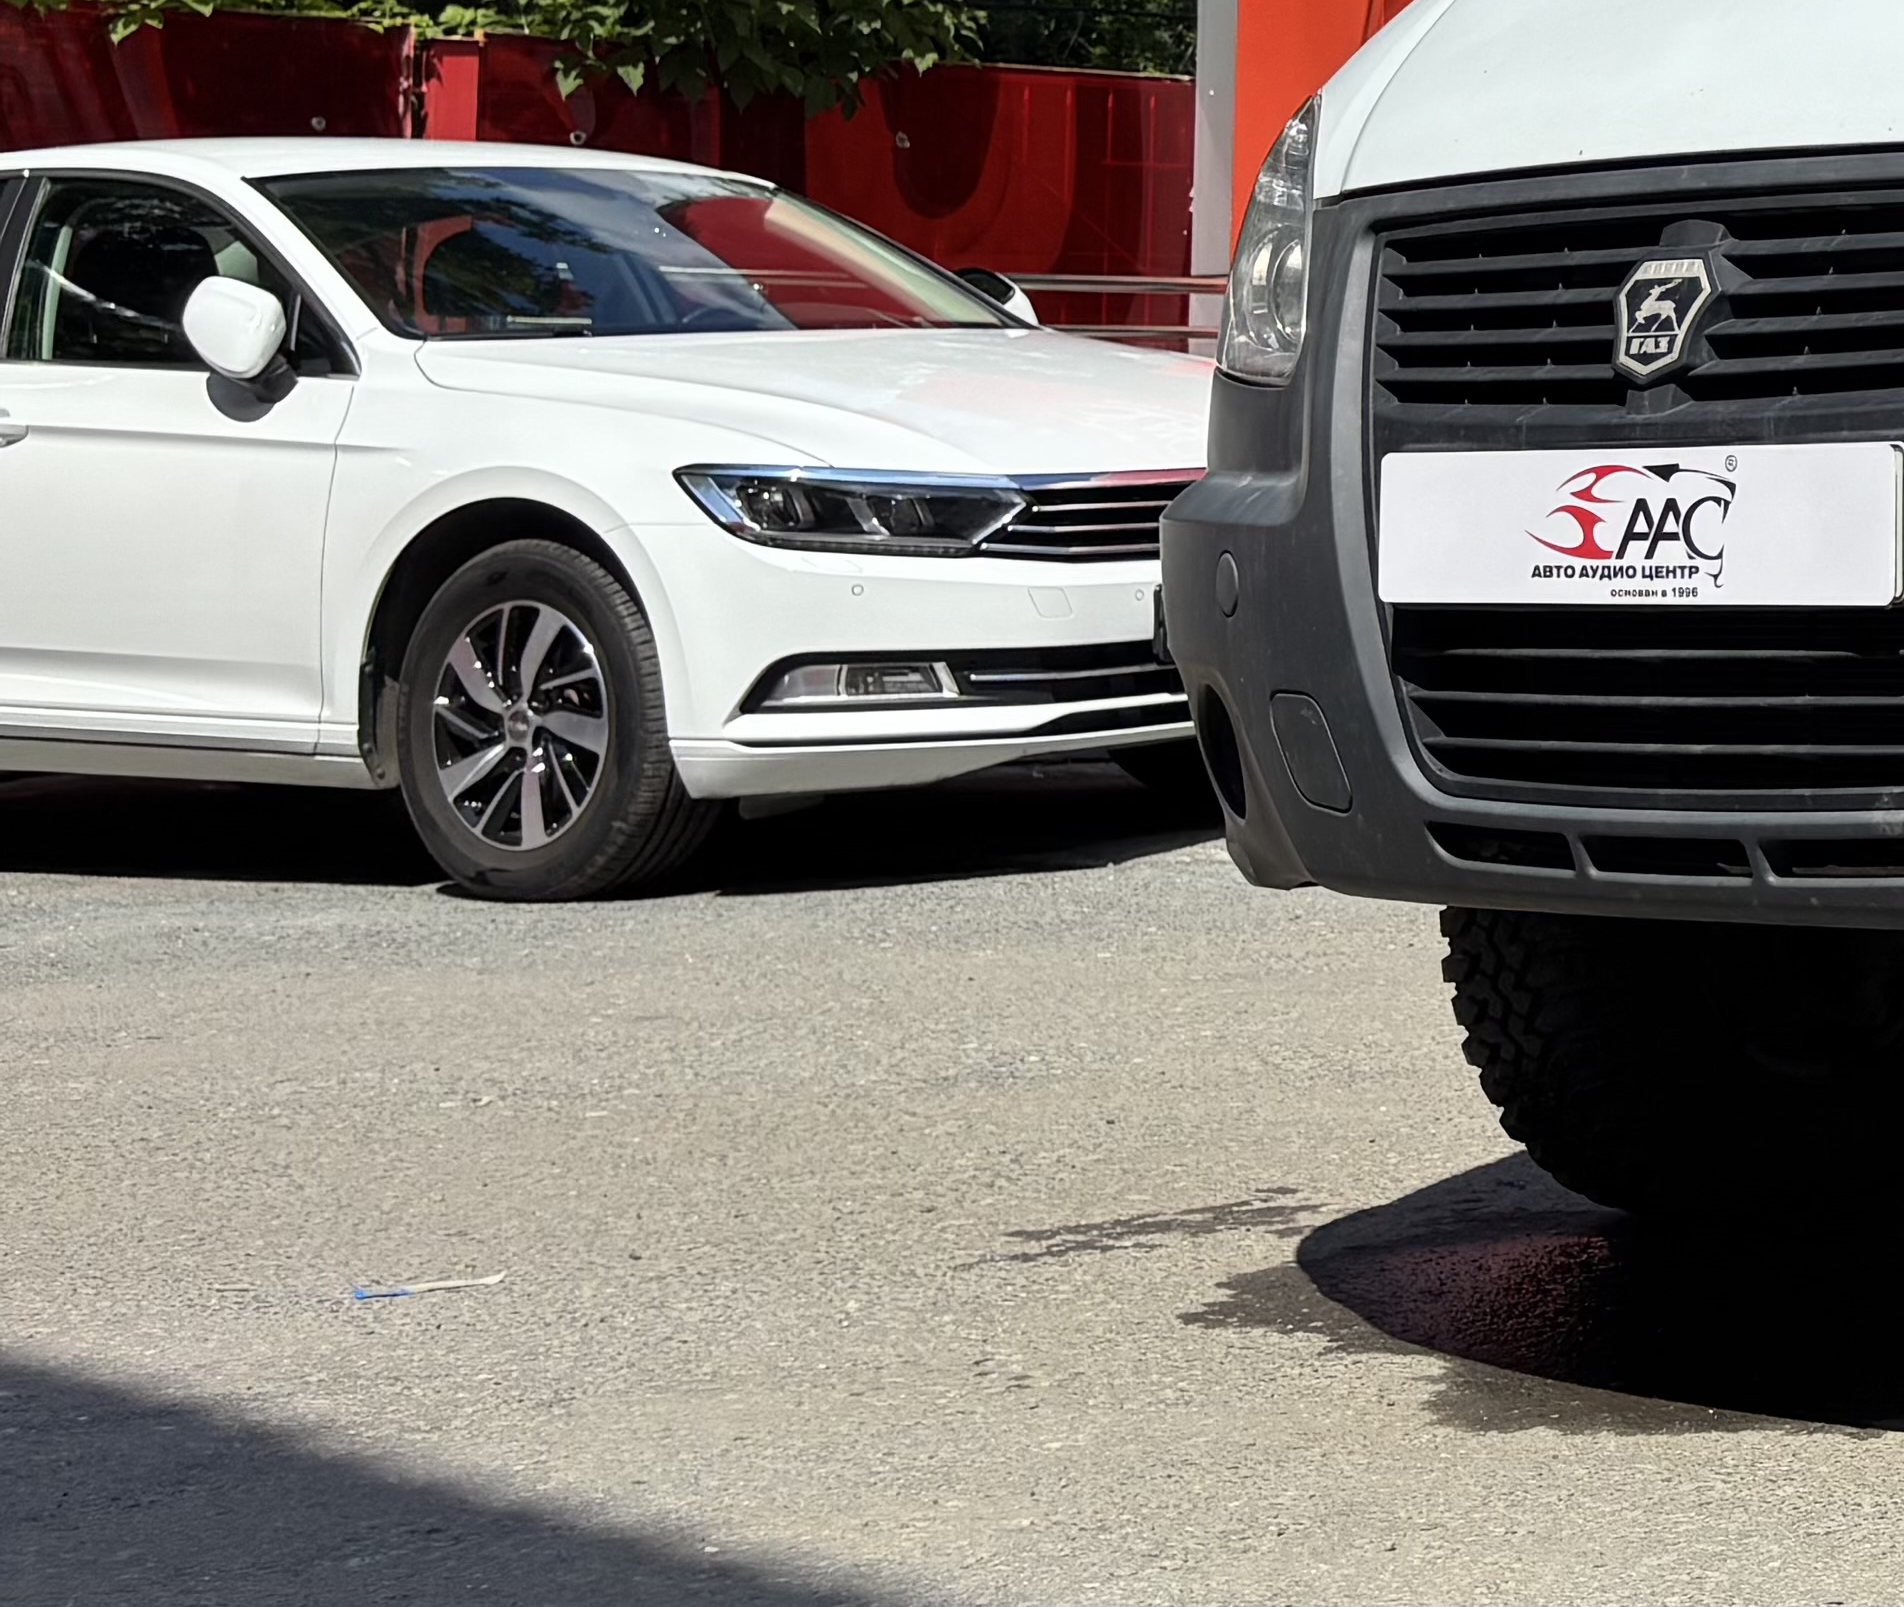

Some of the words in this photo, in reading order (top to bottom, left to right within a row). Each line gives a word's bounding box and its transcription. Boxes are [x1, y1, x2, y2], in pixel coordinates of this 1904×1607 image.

[1629, 336, 1671, 355] ГАЗ
[1530, 564, 1576, 580] АВТО
[1578, 564, 1637, 581] АУДИО
[1641, 564, 1701, 581] ЦЕНТР
[1610, 588, 1659, 598] основан
[1671, 586, 1699, 598] 1996
